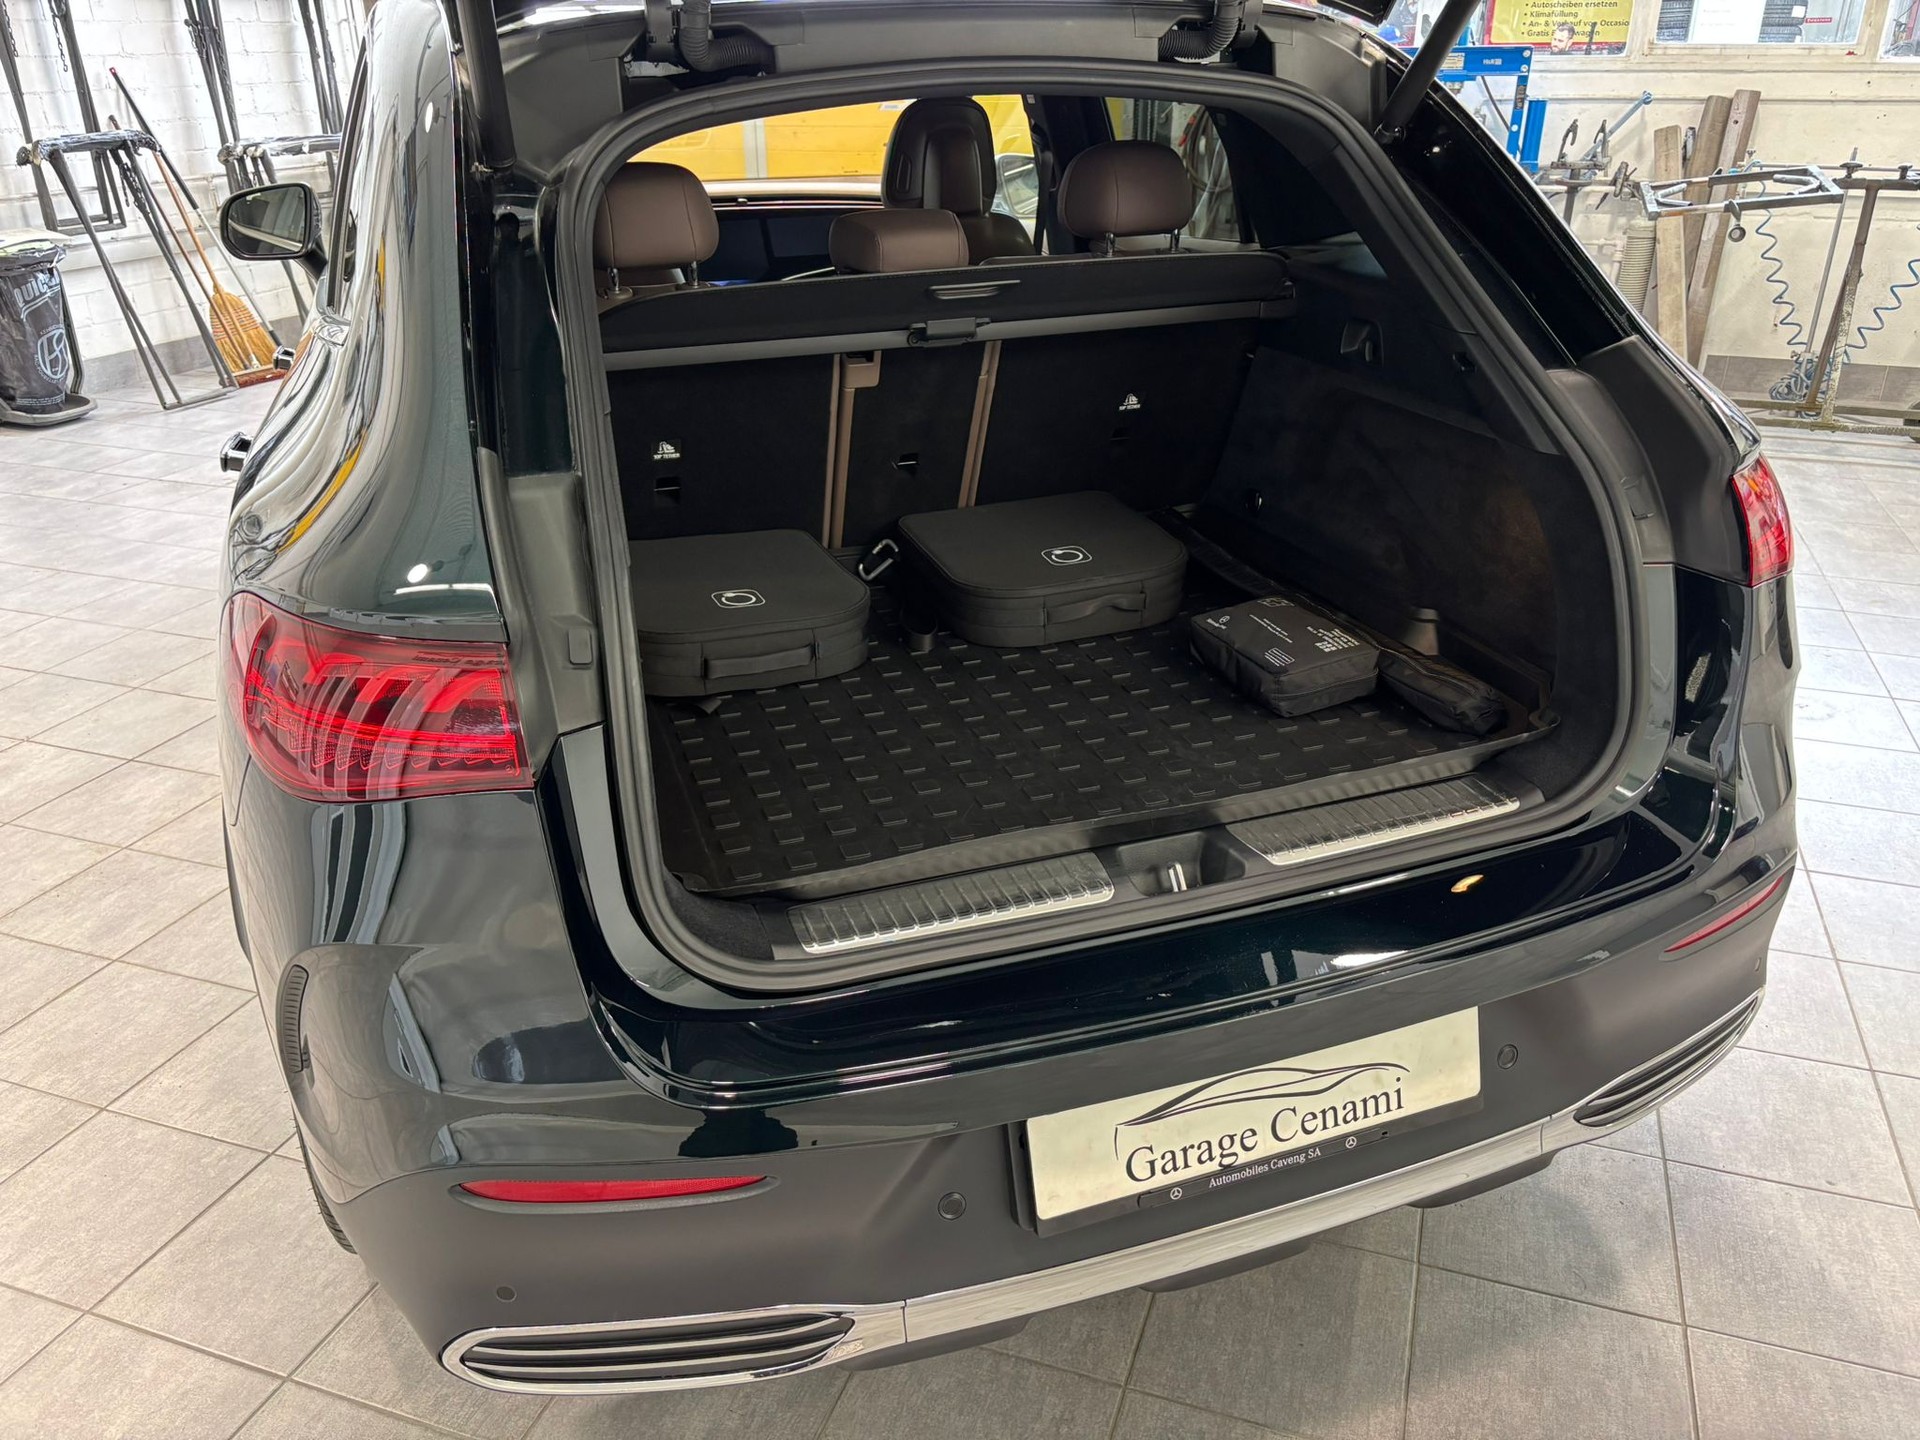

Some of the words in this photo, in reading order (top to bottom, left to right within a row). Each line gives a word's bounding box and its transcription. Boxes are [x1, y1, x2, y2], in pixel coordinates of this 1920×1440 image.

[1529, 10, 1579, 18] Klimafüllung
[1527, 29, 1550, 37] Gratis
[1125, 1127, 1259, 1183] Garage
[1270, 1076, 1405, 1143] Cenami
[1208, 1162, 1269, 1189] Automobiles
[1270, 1152, 1306, 1170] Caveng
[1307, 1147, 1322, 1159] SA
